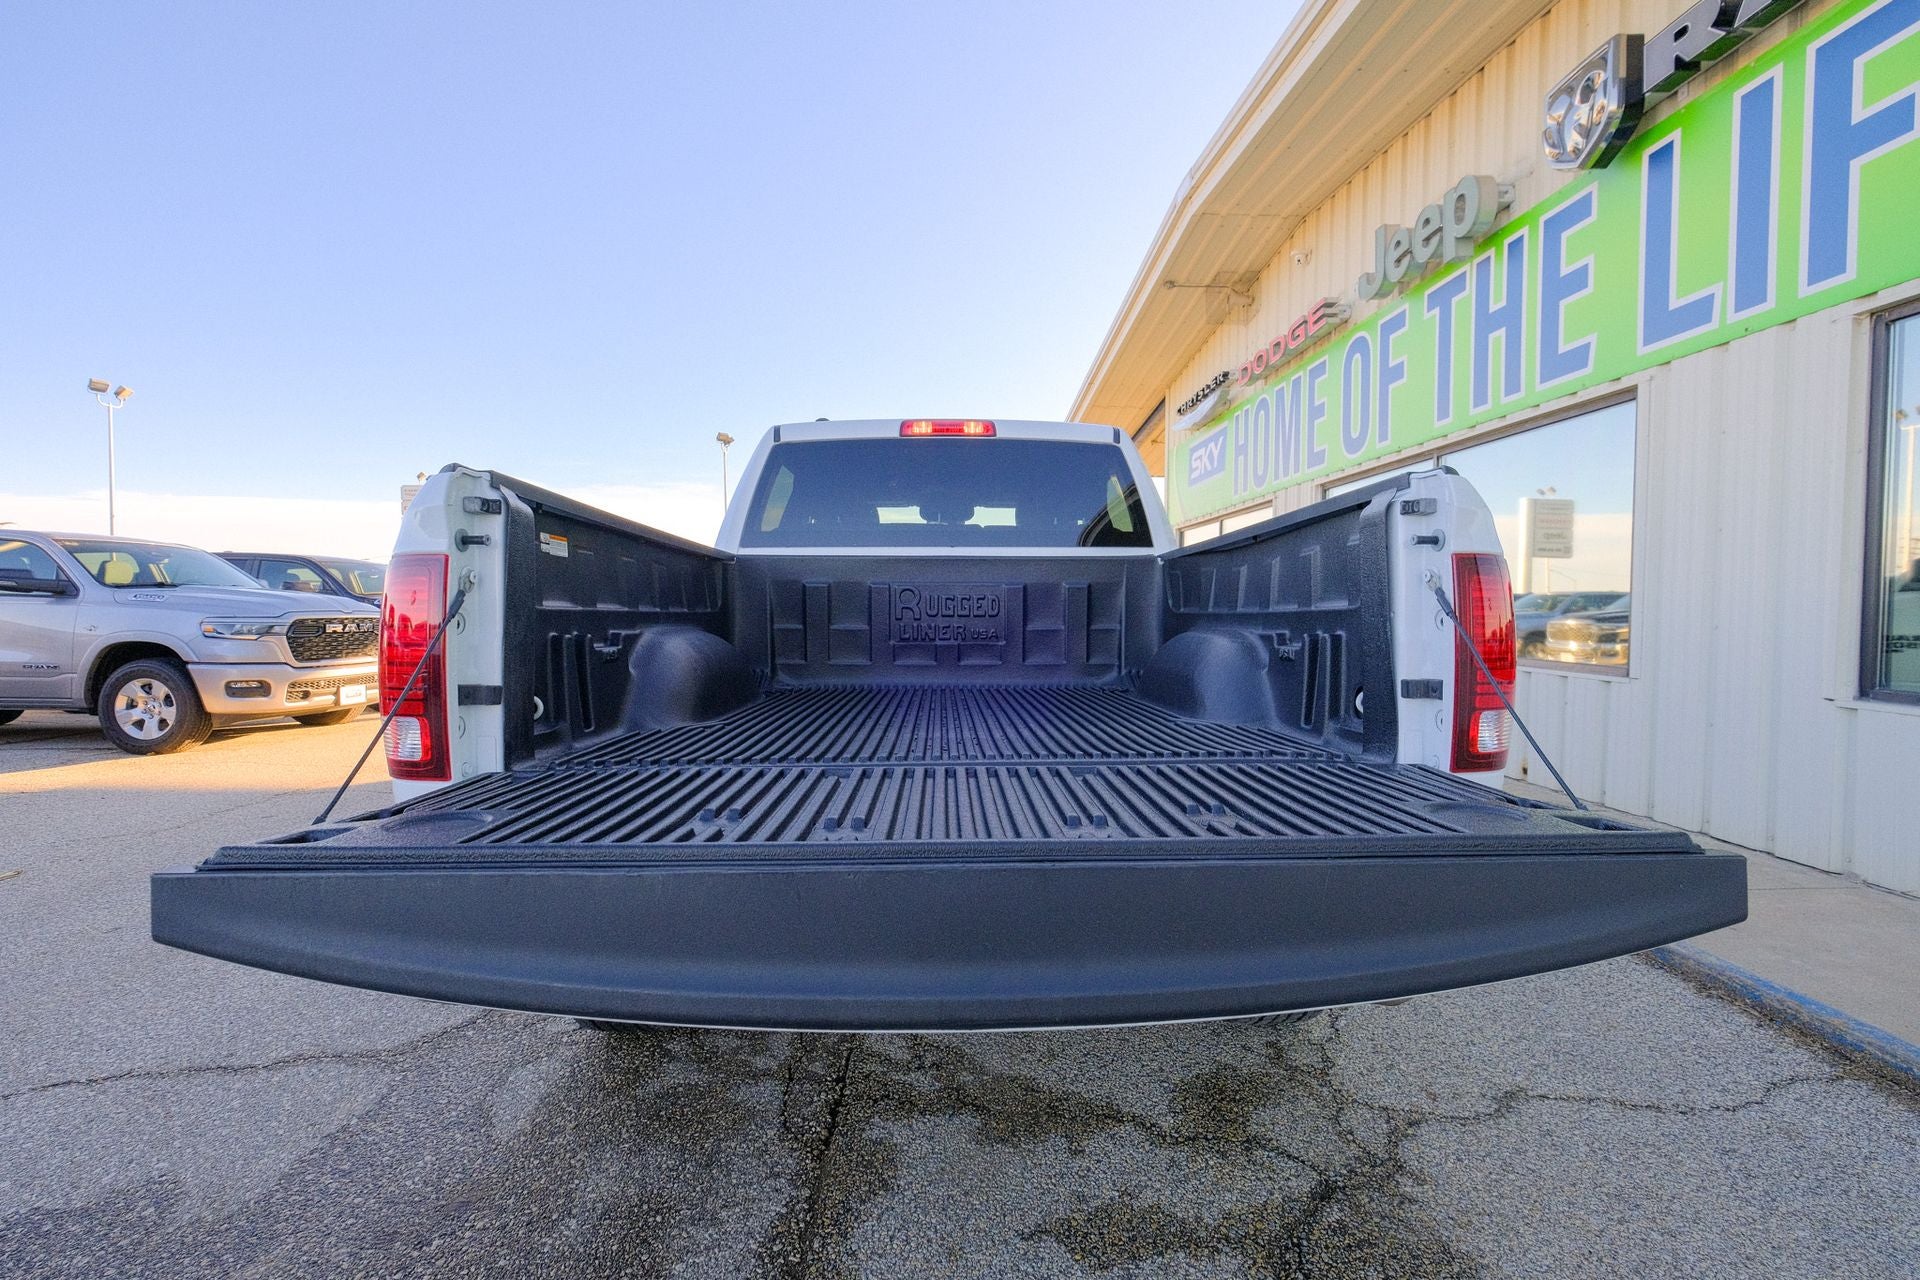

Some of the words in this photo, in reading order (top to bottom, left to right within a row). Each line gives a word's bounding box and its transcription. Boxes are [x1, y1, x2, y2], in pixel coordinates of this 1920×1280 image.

[1358, 175, 1490, 300] Jeep
[1233, 355, 1329, 498] HOME
[1341, 304, 1408, 459] OF
[1423, 181, 1598, 428] THE
[1238, 297, 1330, 385] DODGE
[1190, 435, 1224, 480] SKY
[894, 584, 1001, 621] RUGGED
[325, 623, 375, 634] RAM
[899, 622, 967, 641] LINER
[970, 627, 999, 640] USA
